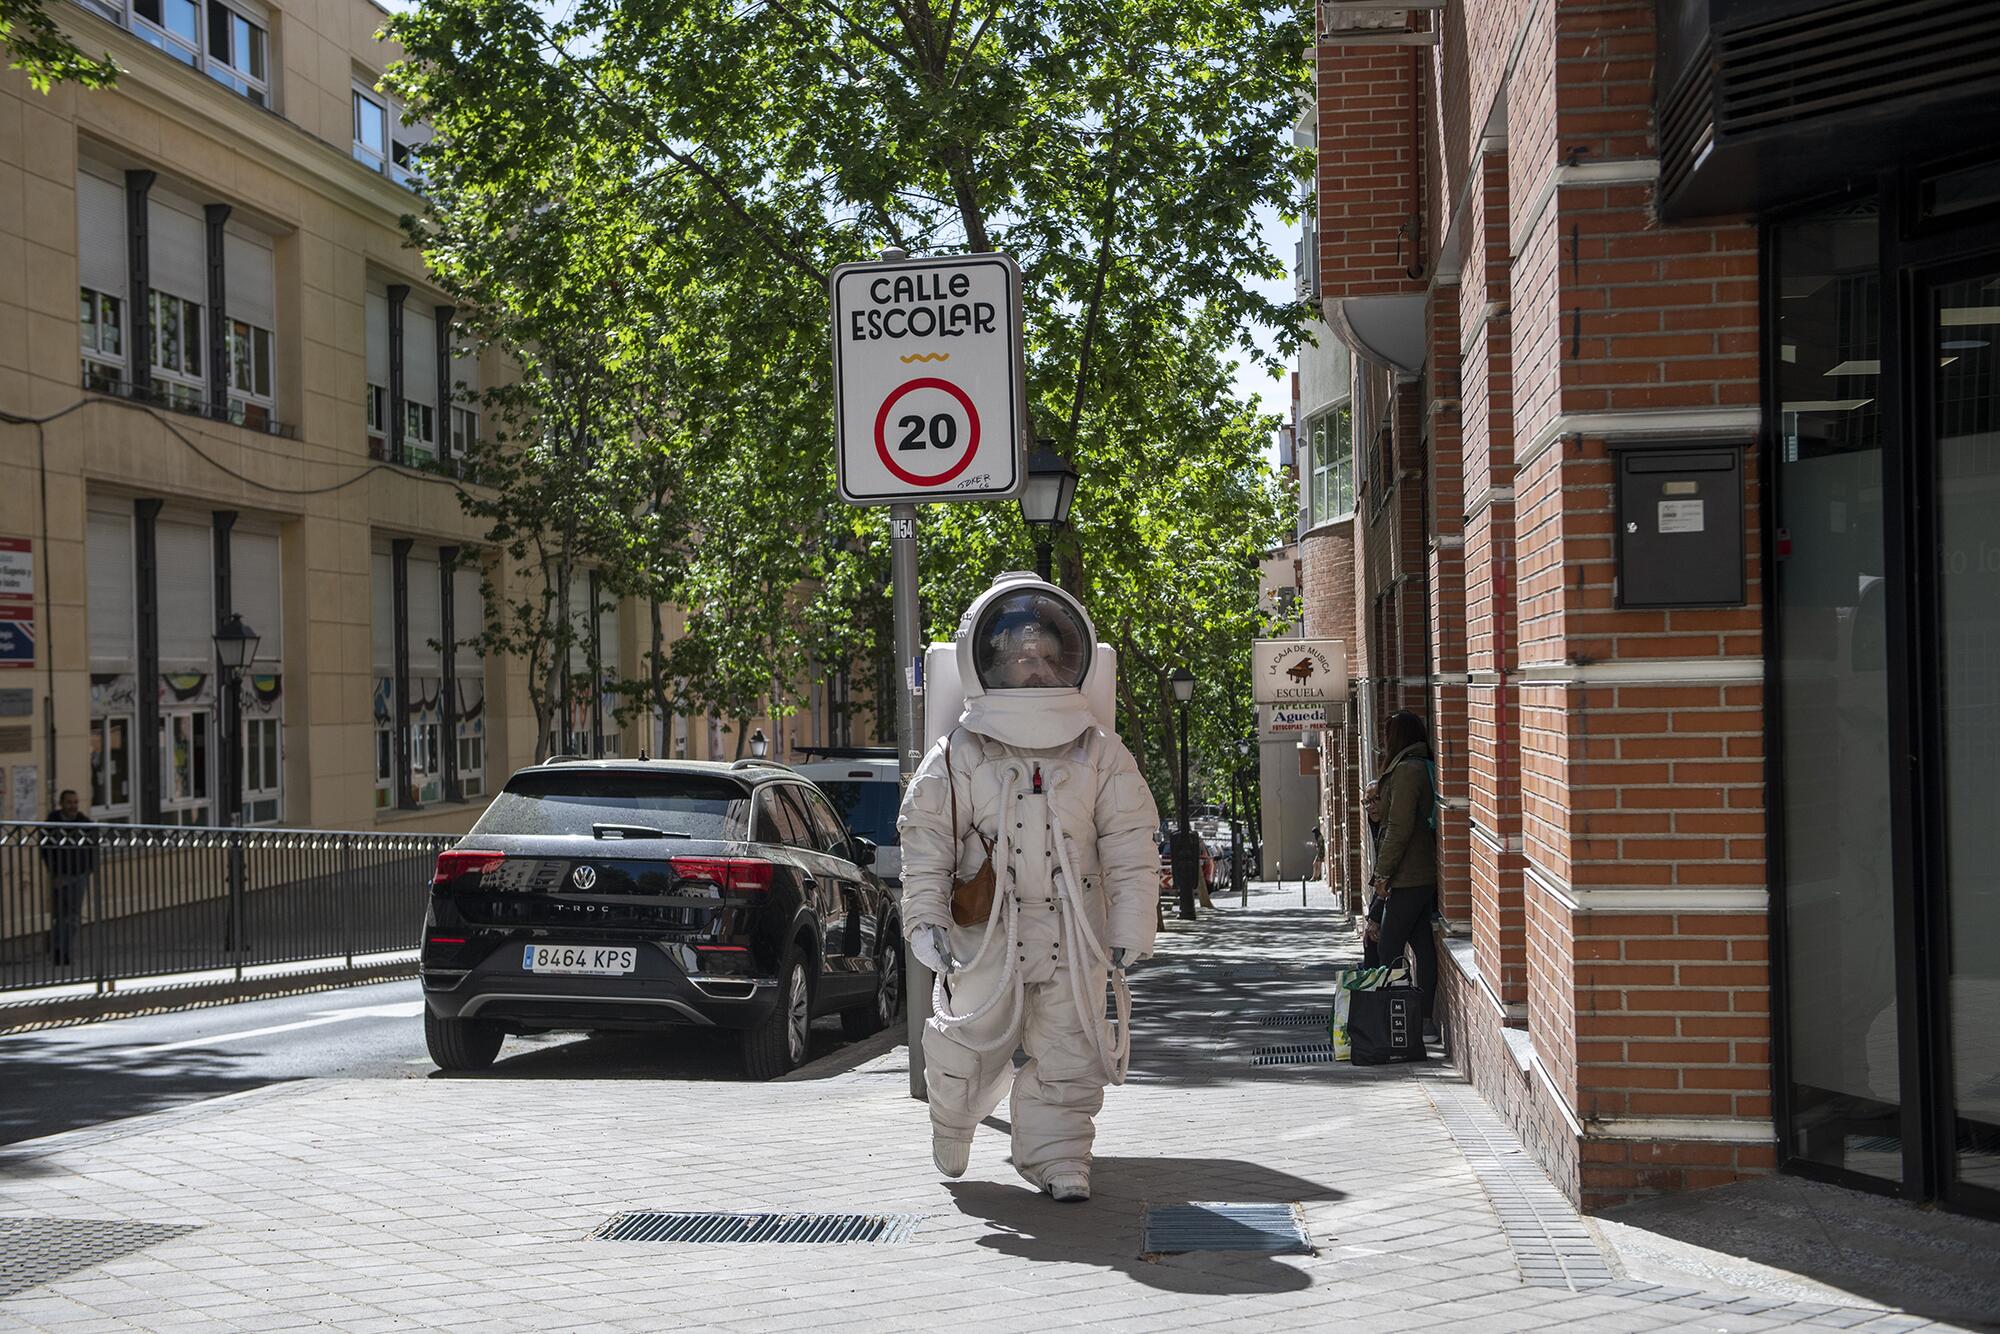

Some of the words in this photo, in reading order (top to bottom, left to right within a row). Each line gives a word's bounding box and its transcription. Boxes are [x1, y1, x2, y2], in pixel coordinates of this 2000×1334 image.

[851, 302, 996, 341] ESCOLAR
[898, 413, 957, 451] 20
[1269, 664, 1277, 675] LA
[1273, 647, 1292, 664] CAJA
[1307, 646, 1331, 675] MUSICA
[1276, 688, 1325, 698] ESCUELA
[555, 904, 609, 912] T-ROC
[537, 949, 586, 968] 8464
[594, 950, 632, 969] KPS
